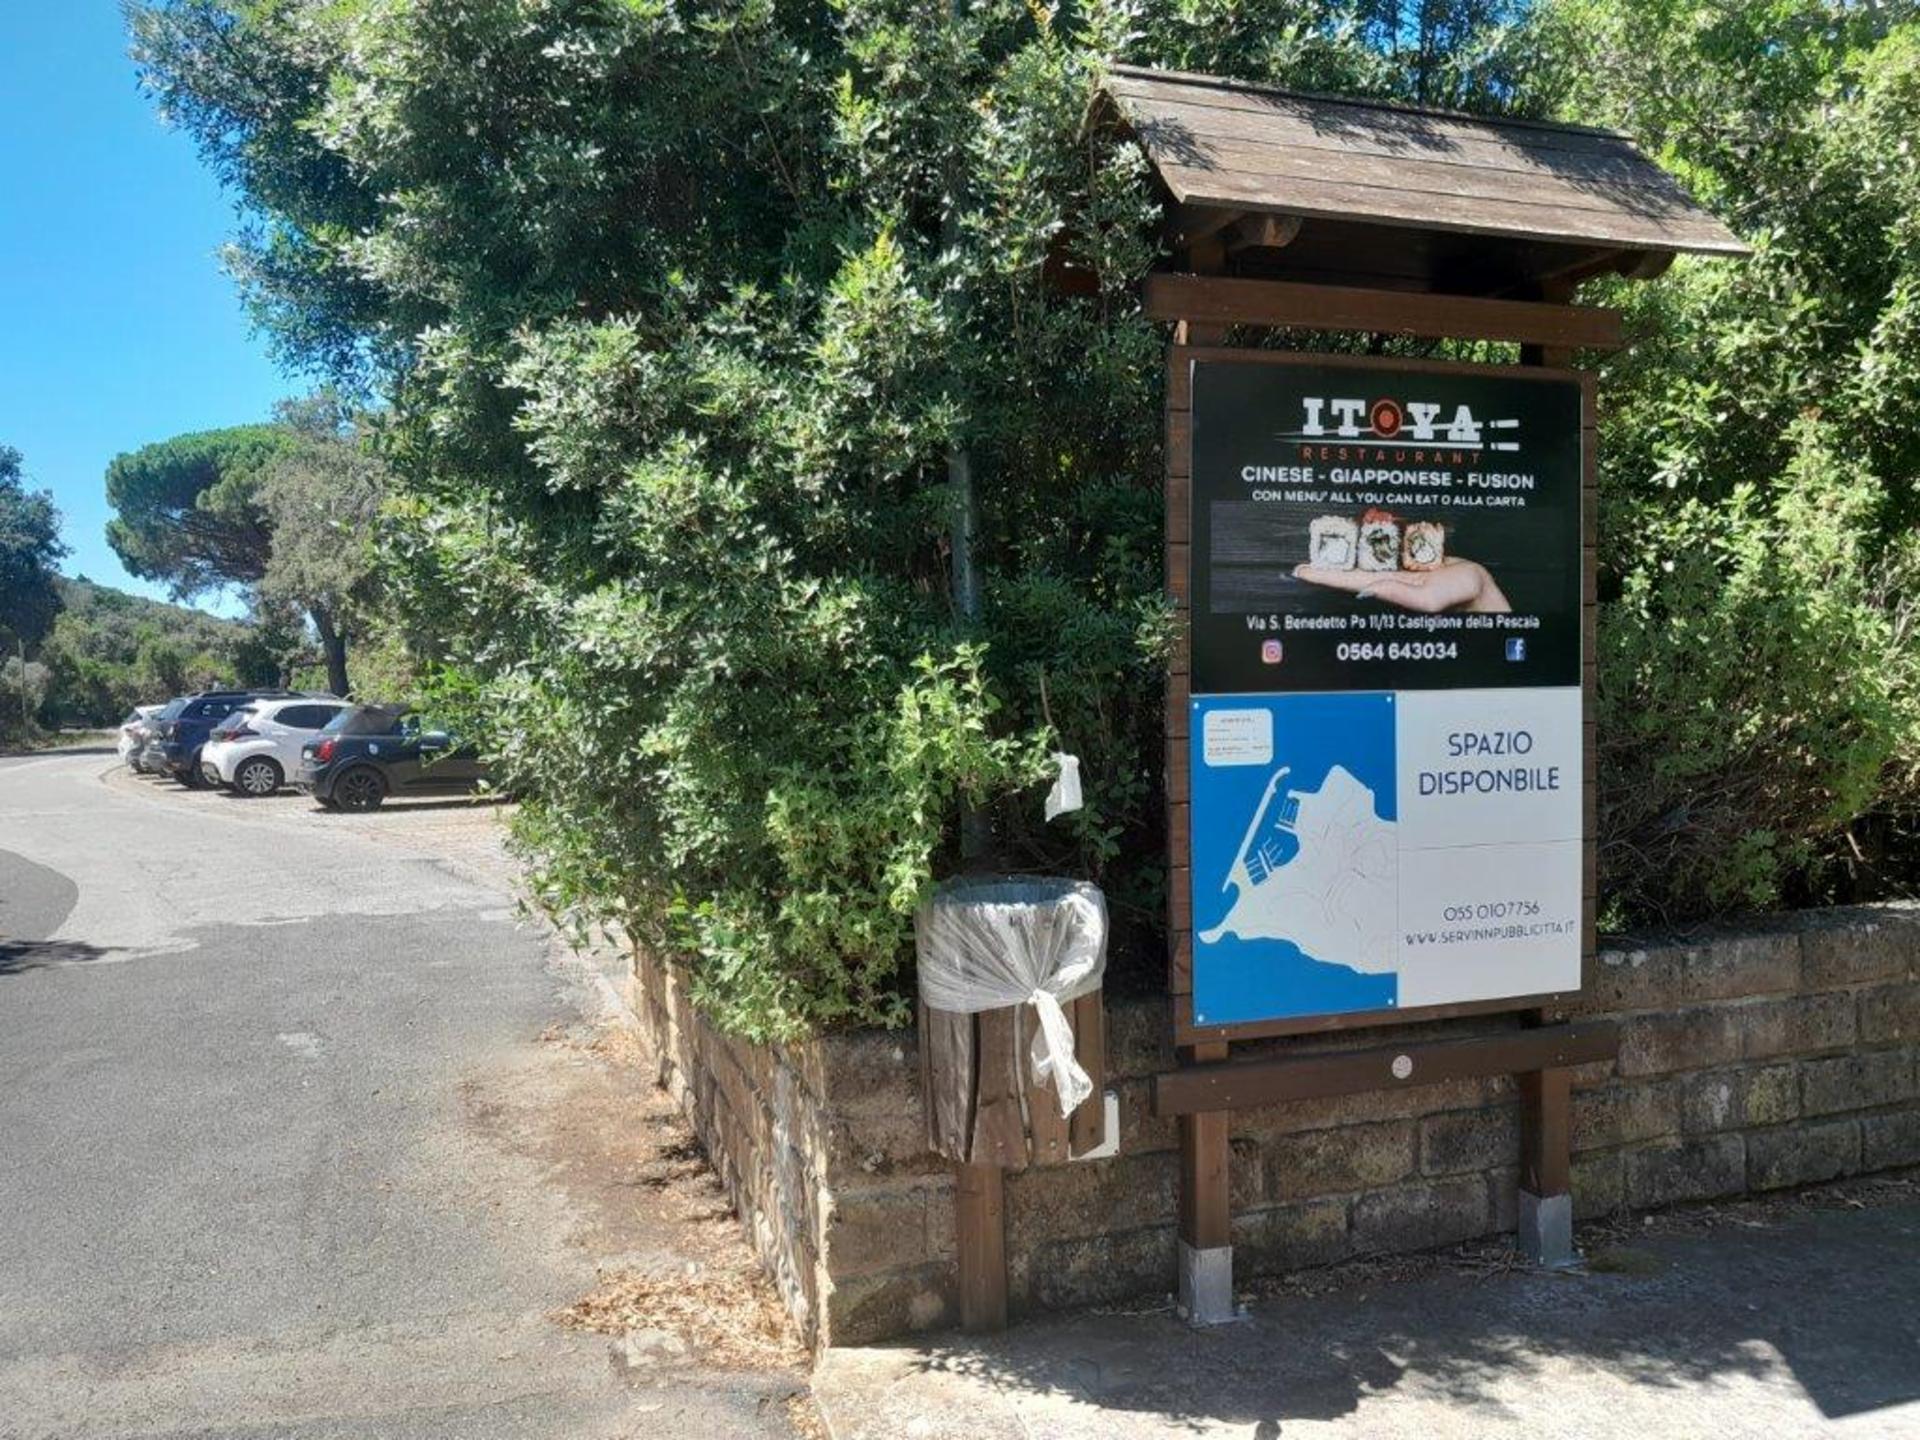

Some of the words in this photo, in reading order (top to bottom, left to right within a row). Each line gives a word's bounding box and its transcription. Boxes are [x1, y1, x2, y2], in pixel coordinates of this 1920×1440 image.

[1302, 446, 1481, 464] RESTAURANT
[1241, 466, 1314, 483] CINESE
[1330, 468, 1452, 486] GIAPPONESE
[1467, 472, 1534, 489] FUSION
[1252, 490, 1282, 501] CON
[1329, 492, 1354, 503] ALL
[1356, 492, 1384, 503] YOU
[1386, 493, 1412, 504] CAN
[1415, 494, 1438, 504] EAT
[1441, 494, 1450, 505] O
[1452, 495, 1484, 506] ALLA
[1486, 496, 1526, 507] CARTA
[1246, 614, 1267, 630] Via
[1269, 614, 1281, 630] S.
[1284, 614, 1347, 630] Benedetto
[1351, 614, 1366, 629] Po
[1369, 614, 1395, 631] 11/13
[1398, 614, 1462, 632] Castiglione
[1465, 614, 1494, 629] della
[1496, 614, 1540, 629] Pescaia
[1336, 643, 1384, 660] 0564
[1388, 642, 1458, 660] 643034
[1448, 730, 1533, 757] SPAZIO
[1418, 767, 1560, 796] DISPONBILE
[1443, 904, 1473, 922] 055
[1477, 900, 1541, 919] 0107756
